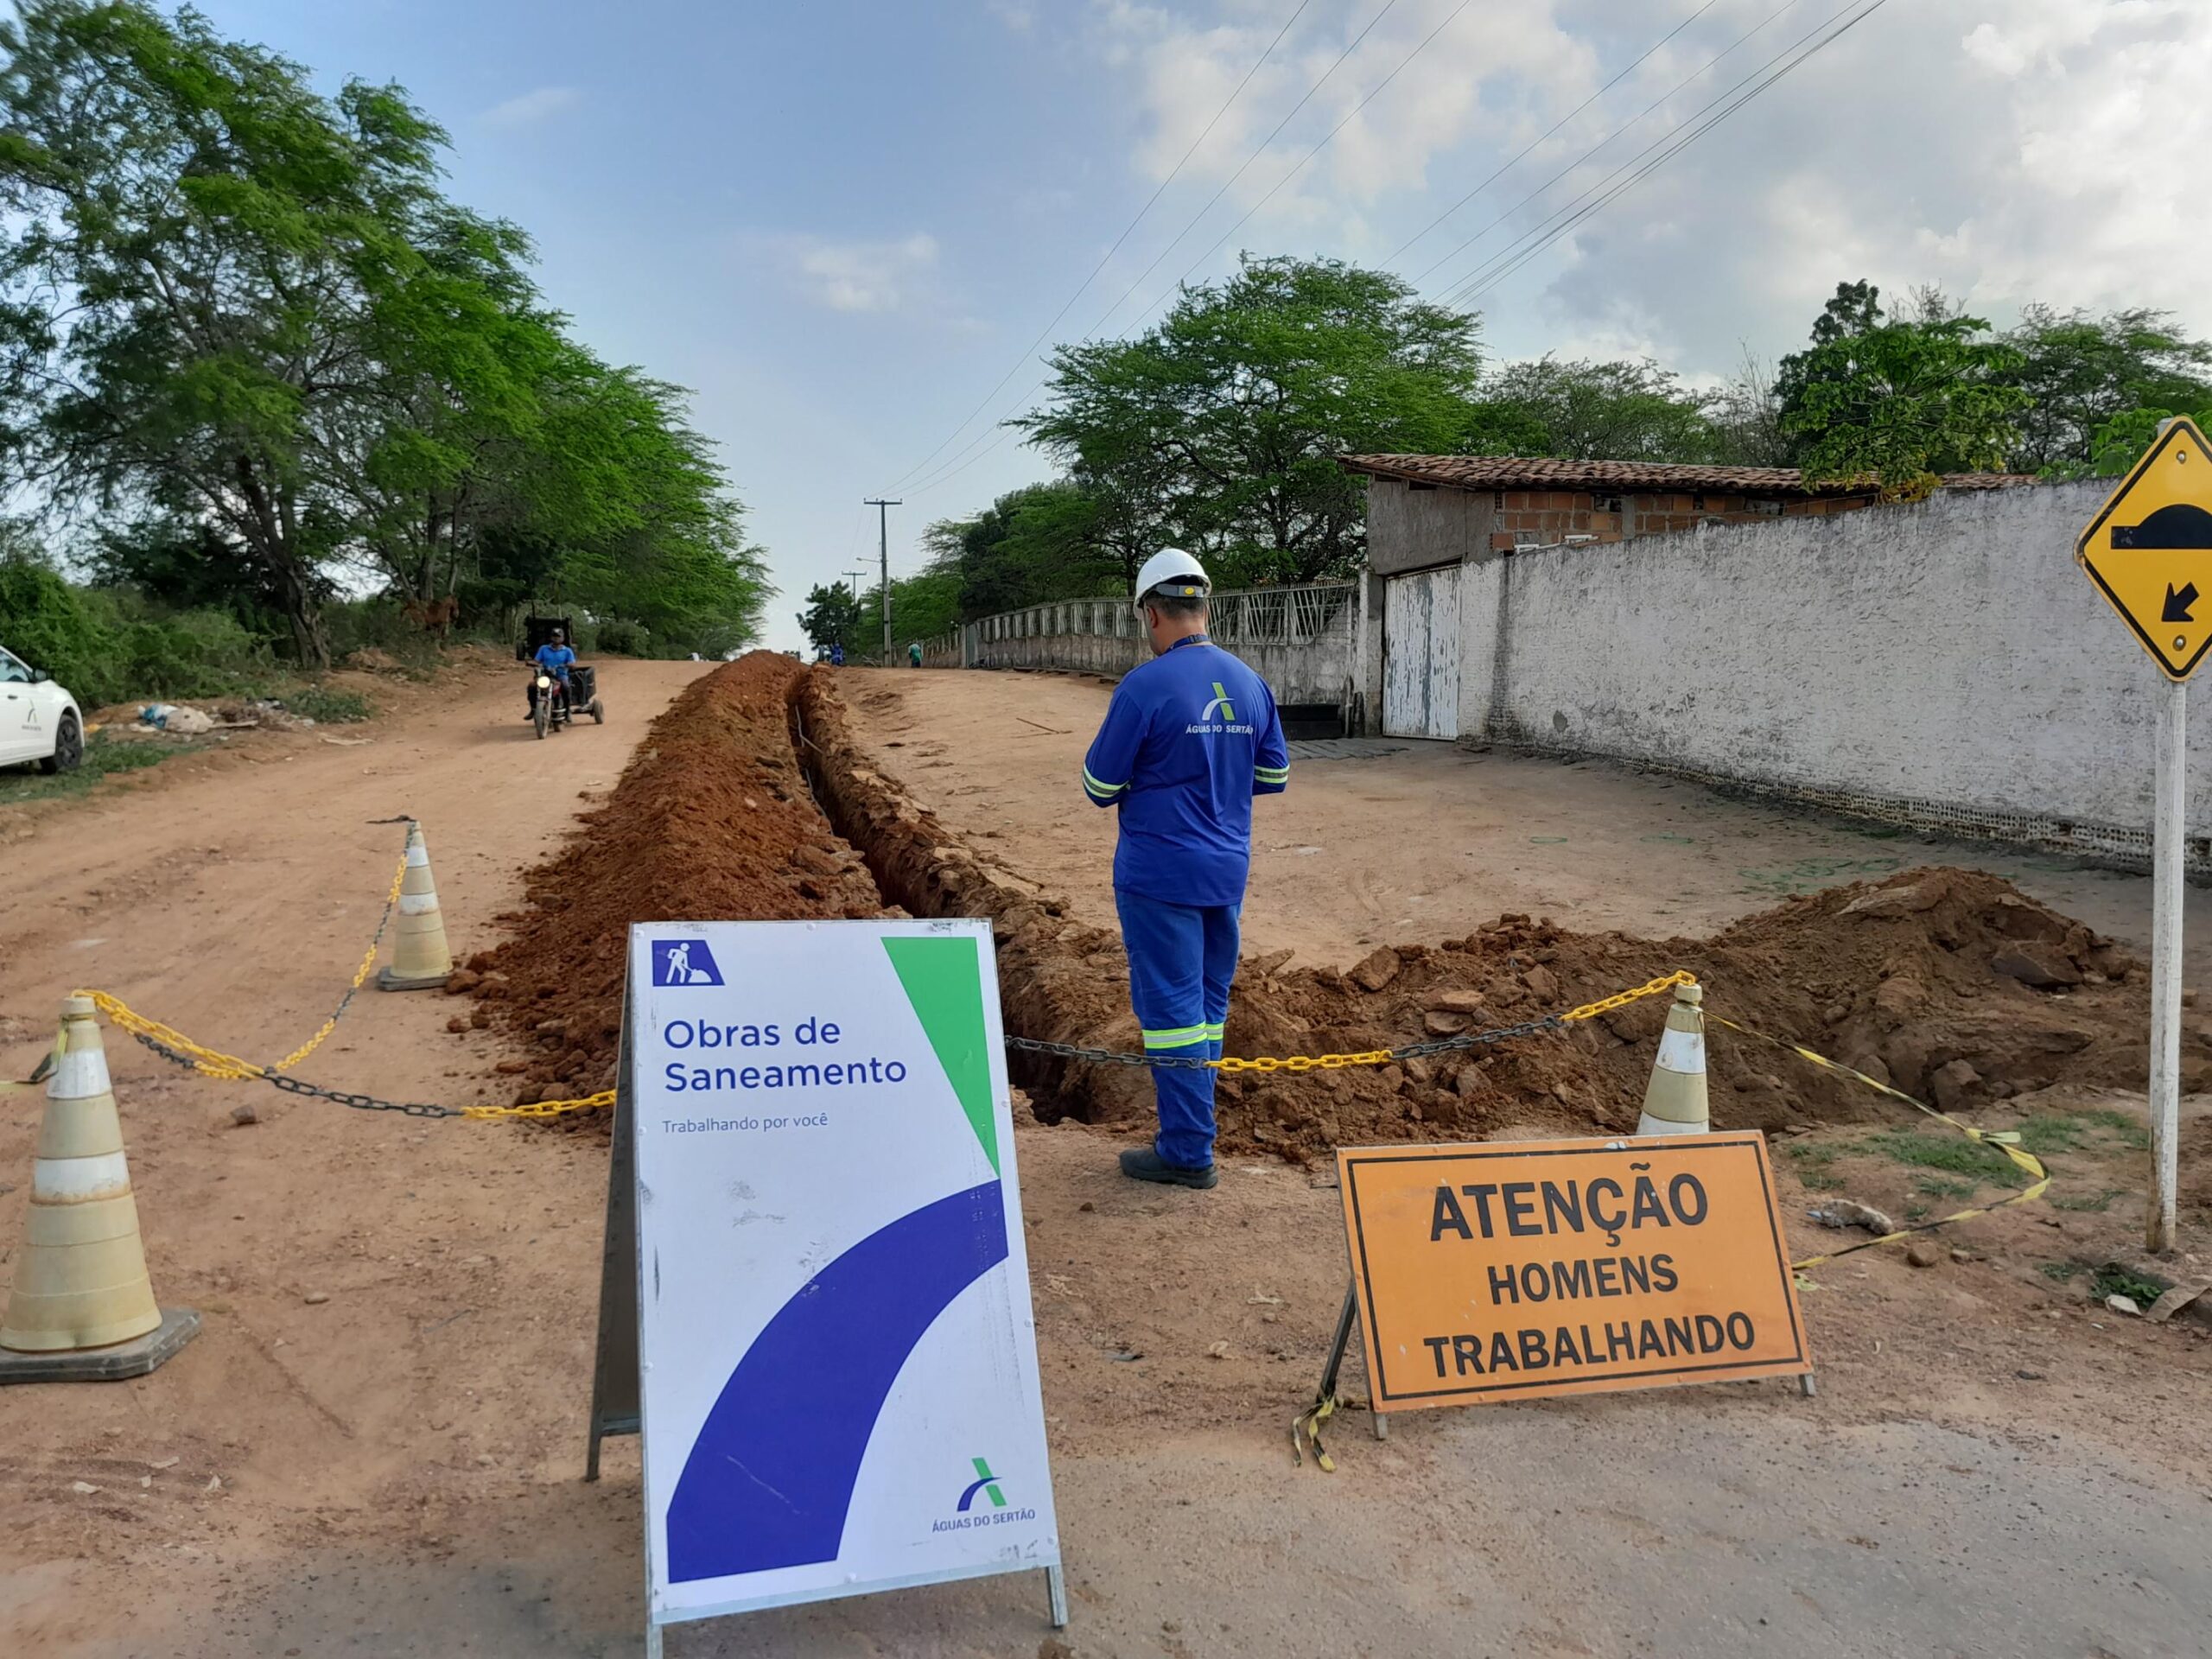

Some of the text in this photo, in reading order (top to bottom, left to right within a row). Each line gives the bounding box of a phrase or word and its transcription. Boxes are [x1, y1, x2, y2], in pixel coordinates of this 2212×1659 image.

[1185, 724, 1211, 734] ÁGUAS
[664, 1016, 841, 1049] Obras de
[664, 1057, 907, 1092] Saneamento
[662, 1112, 829, 1134] Trabalhando por você
[1430, 1162, 1708, 1247] ATENÇÃO
[1487, 1254, 1679, 1305] HOMENS
[1423, 1312, 1755, 1377] TRABALHANDO
[932, 1508, 1036, 1534] ÁGUAS DO SERTÃO
